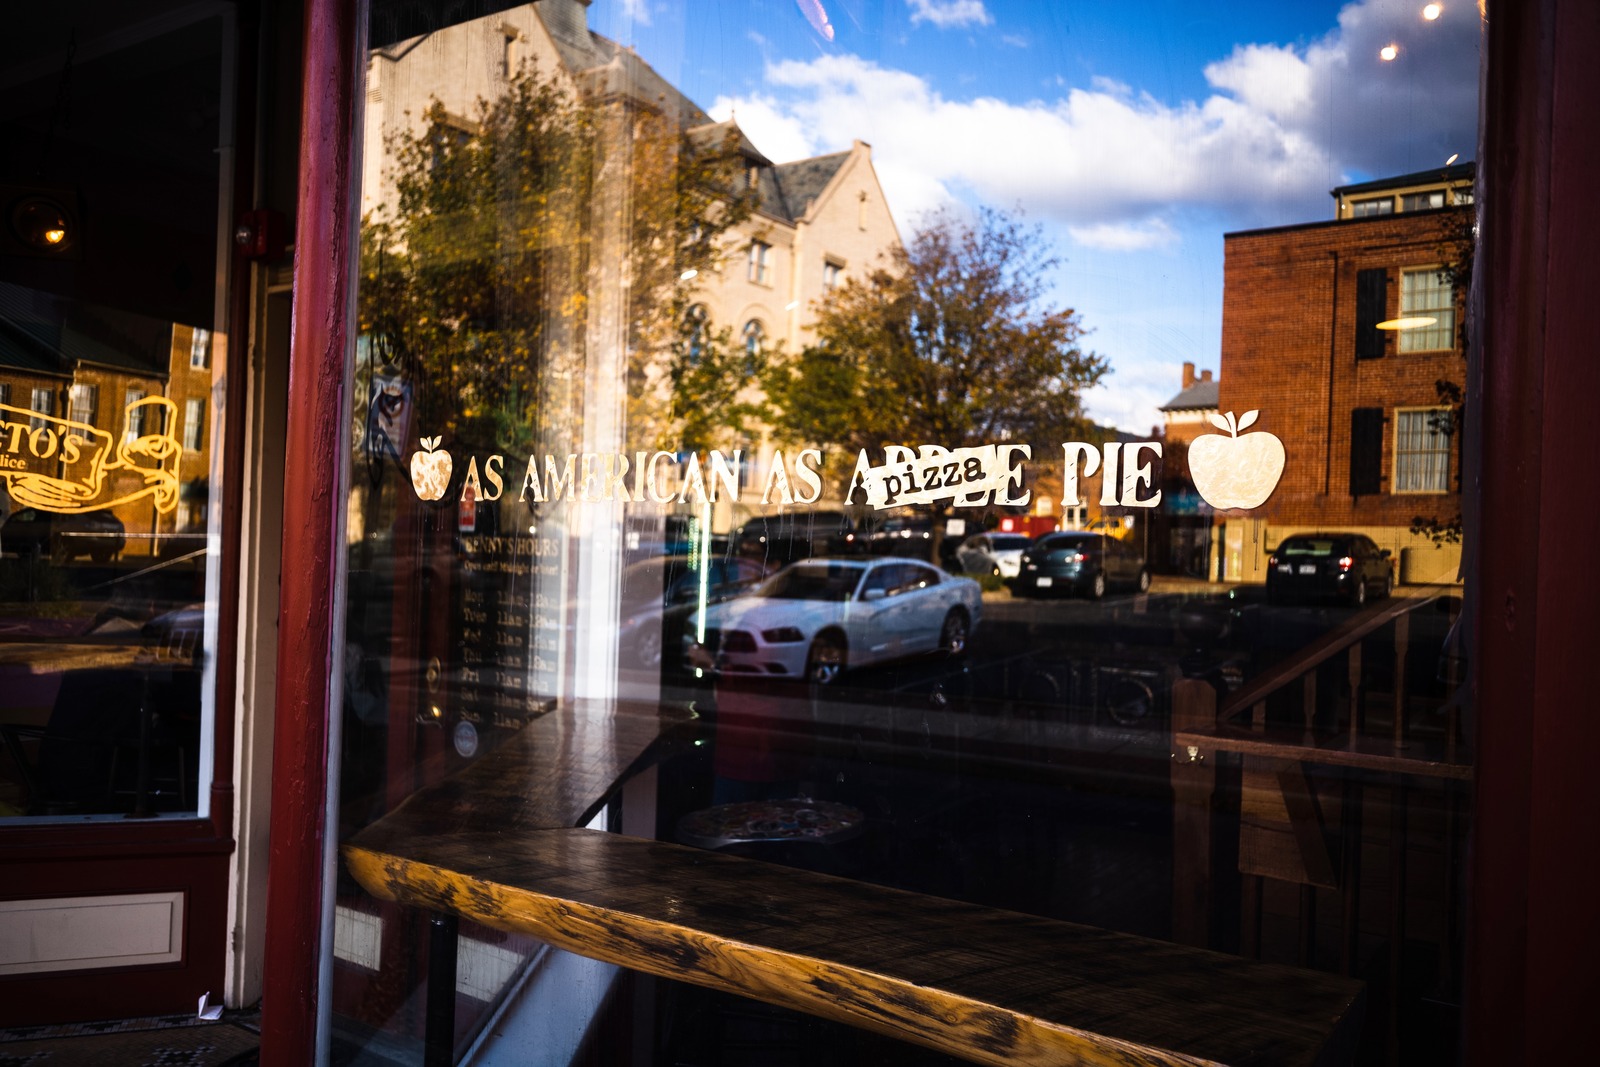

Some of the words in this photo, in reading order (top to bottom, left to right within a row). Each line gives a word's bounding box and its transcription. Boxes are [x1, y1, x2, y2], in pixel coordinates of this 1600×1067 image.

[460, 455, 504, 502] AS
[519, 449, 741, 503] AMERICAN
[760, 449, 823, 504] AS
[1060, 441, 1164, 508] PIE
[883, 457, 986, 505] pizza
[517, 538, 559, 557] HOURS
